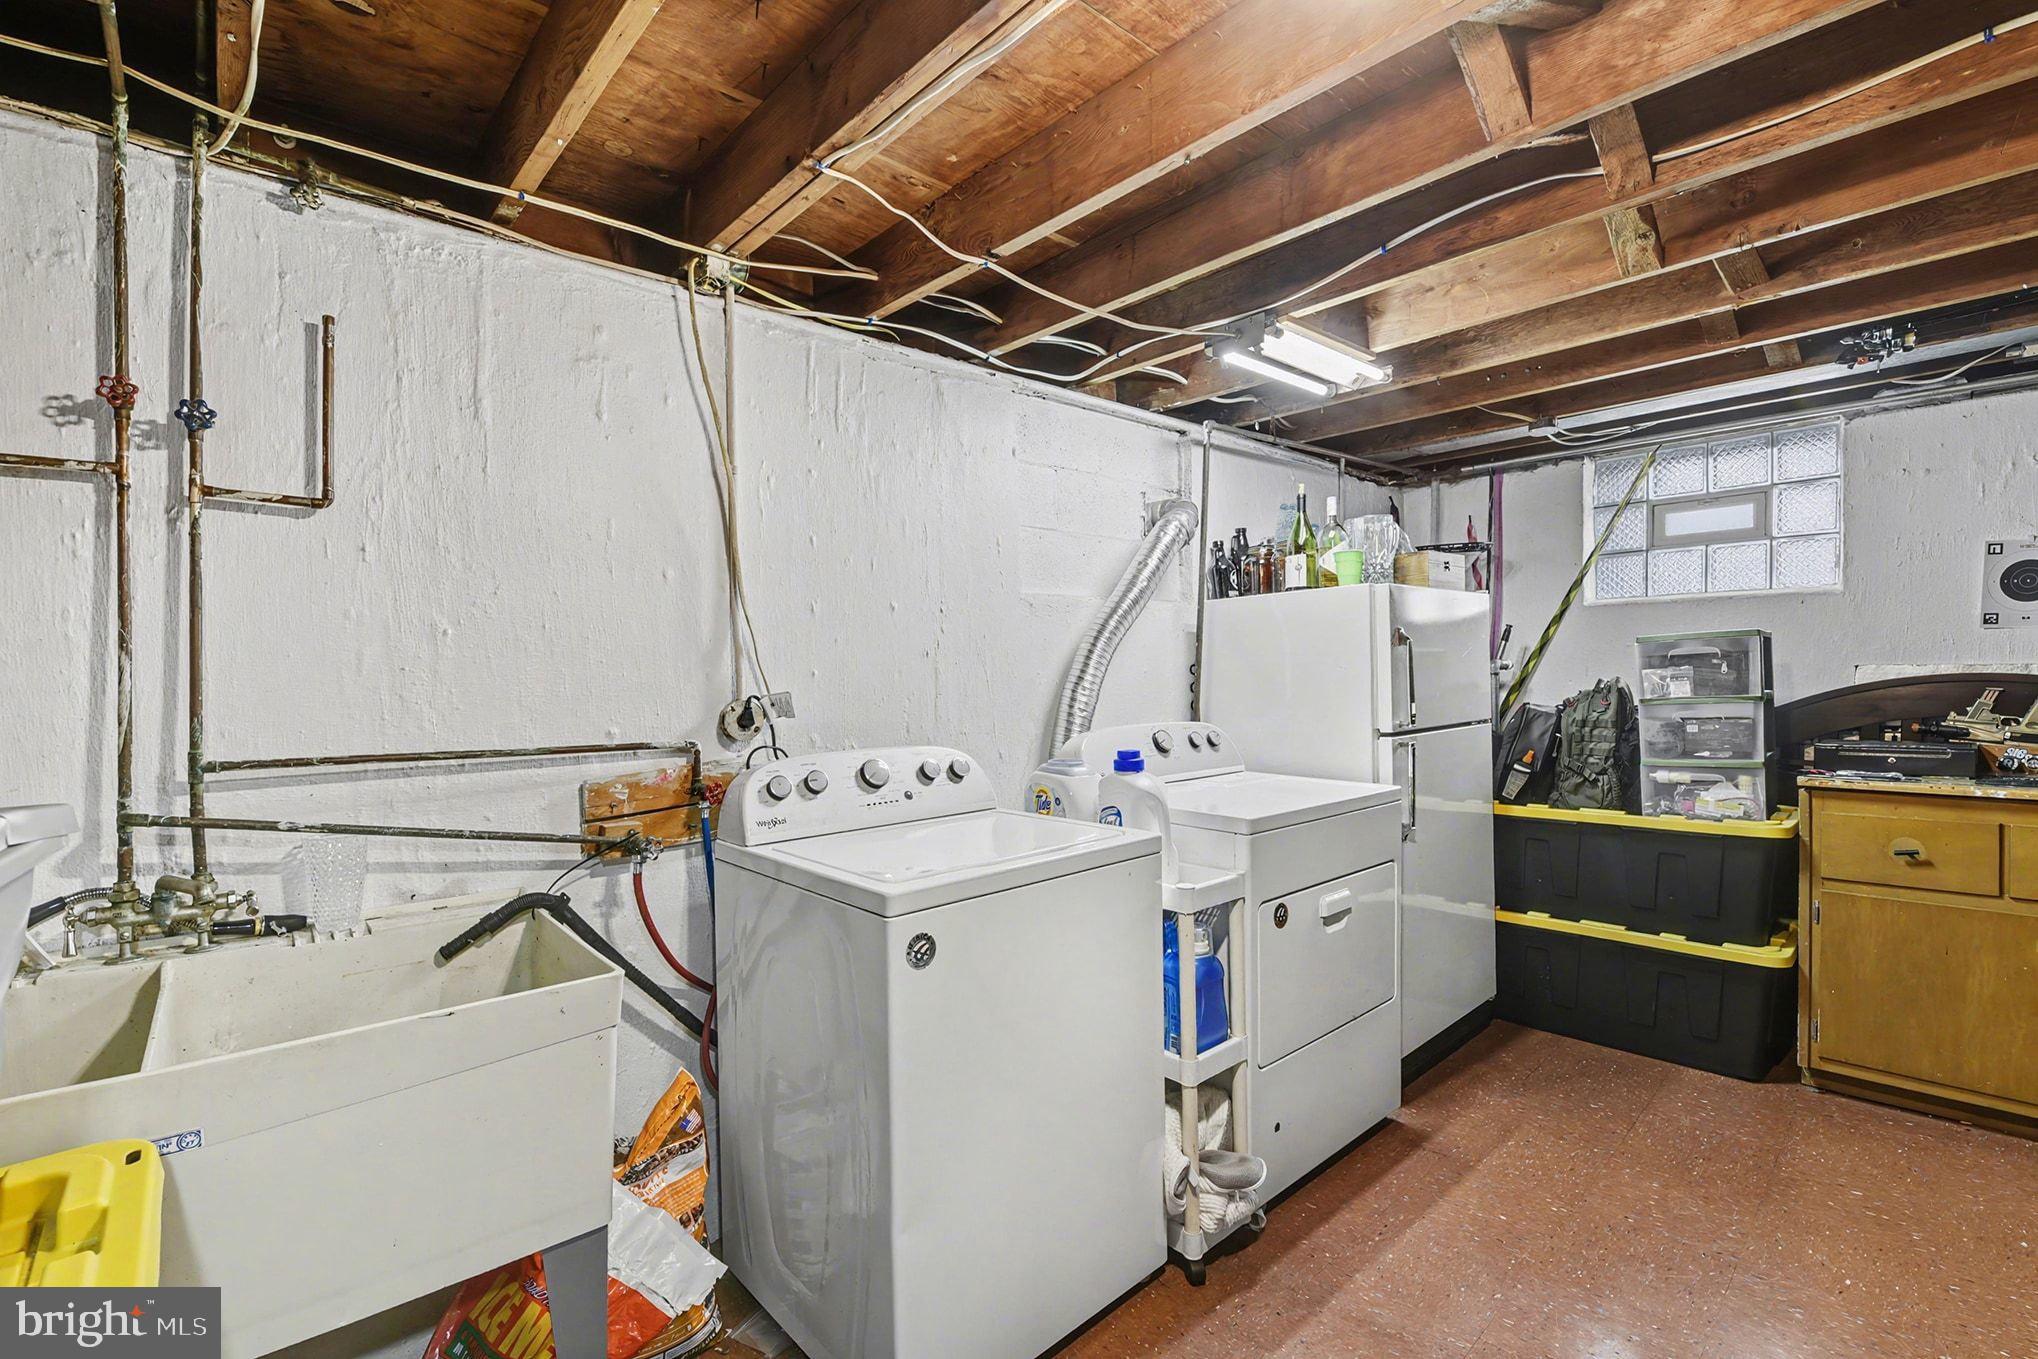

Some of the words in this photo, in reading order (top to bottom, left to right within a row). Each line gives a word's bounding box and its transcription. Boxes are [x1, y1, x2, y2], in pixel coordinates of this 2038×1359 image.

[1035, 794, 1052, 812] Tide
[755, 817, 787, 830] Whirlpool
[468, 1272, 526, 1344] ICE
